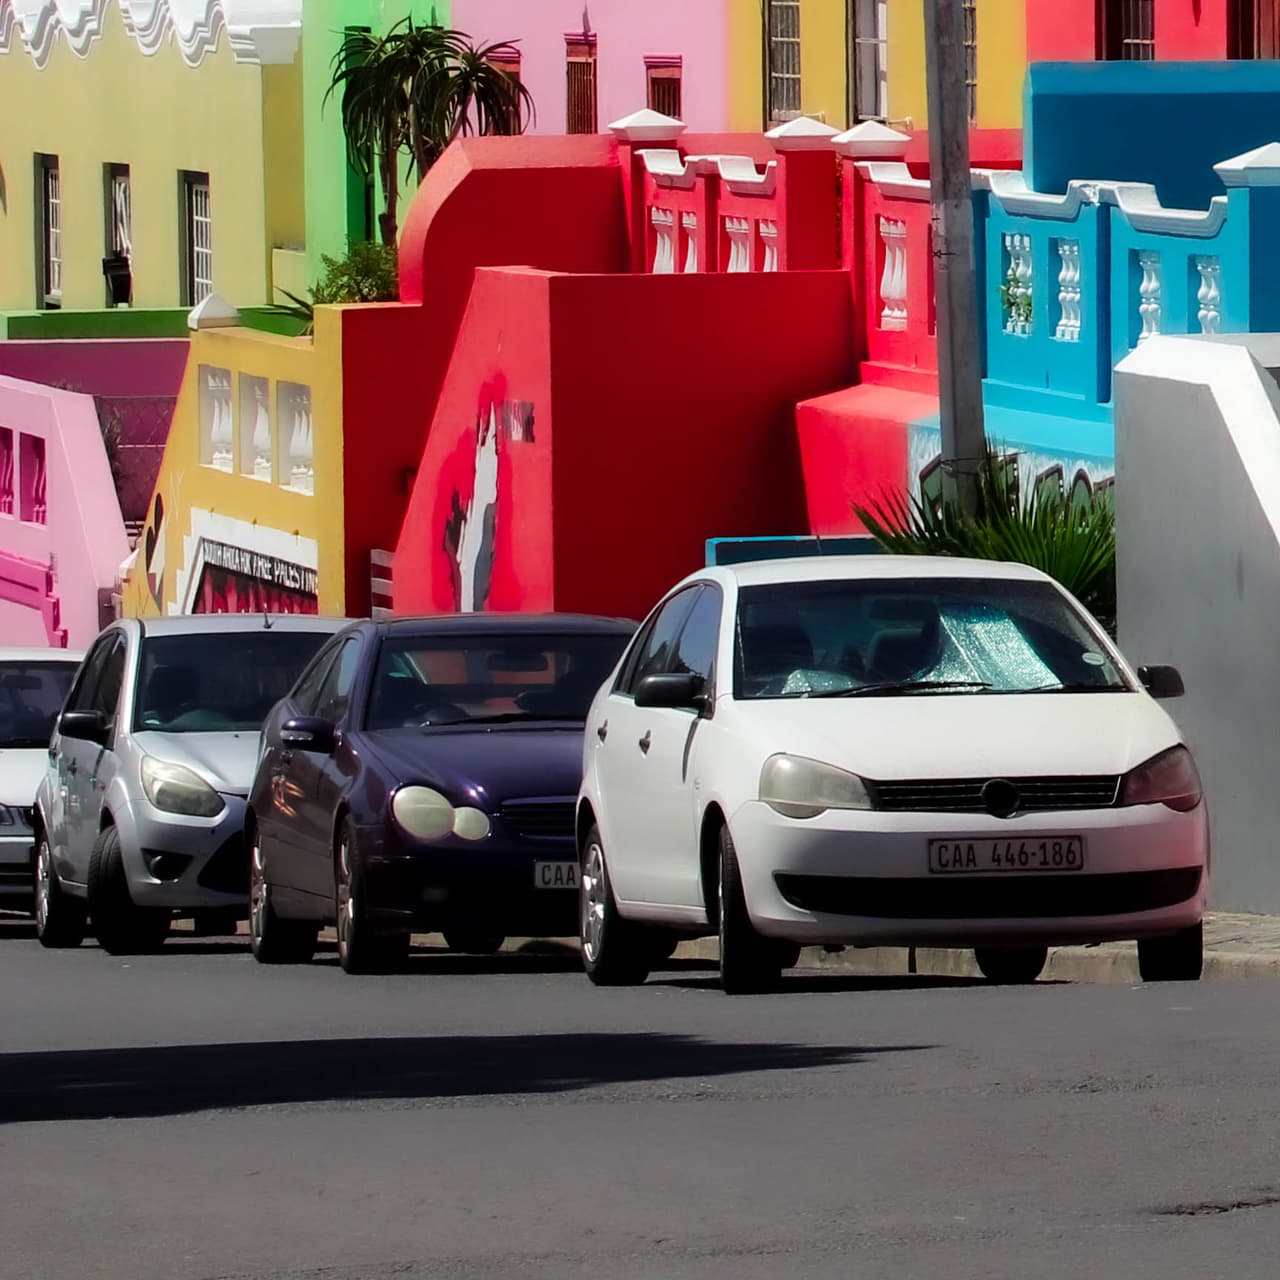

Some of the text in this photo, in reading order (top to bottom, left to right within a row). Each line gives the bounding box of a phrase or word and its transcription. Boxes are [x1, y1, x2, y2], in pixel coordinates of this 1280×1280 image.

[938, 841, 1077, 869] CAA 446-186
[541, 864, 576, 886] CAA
